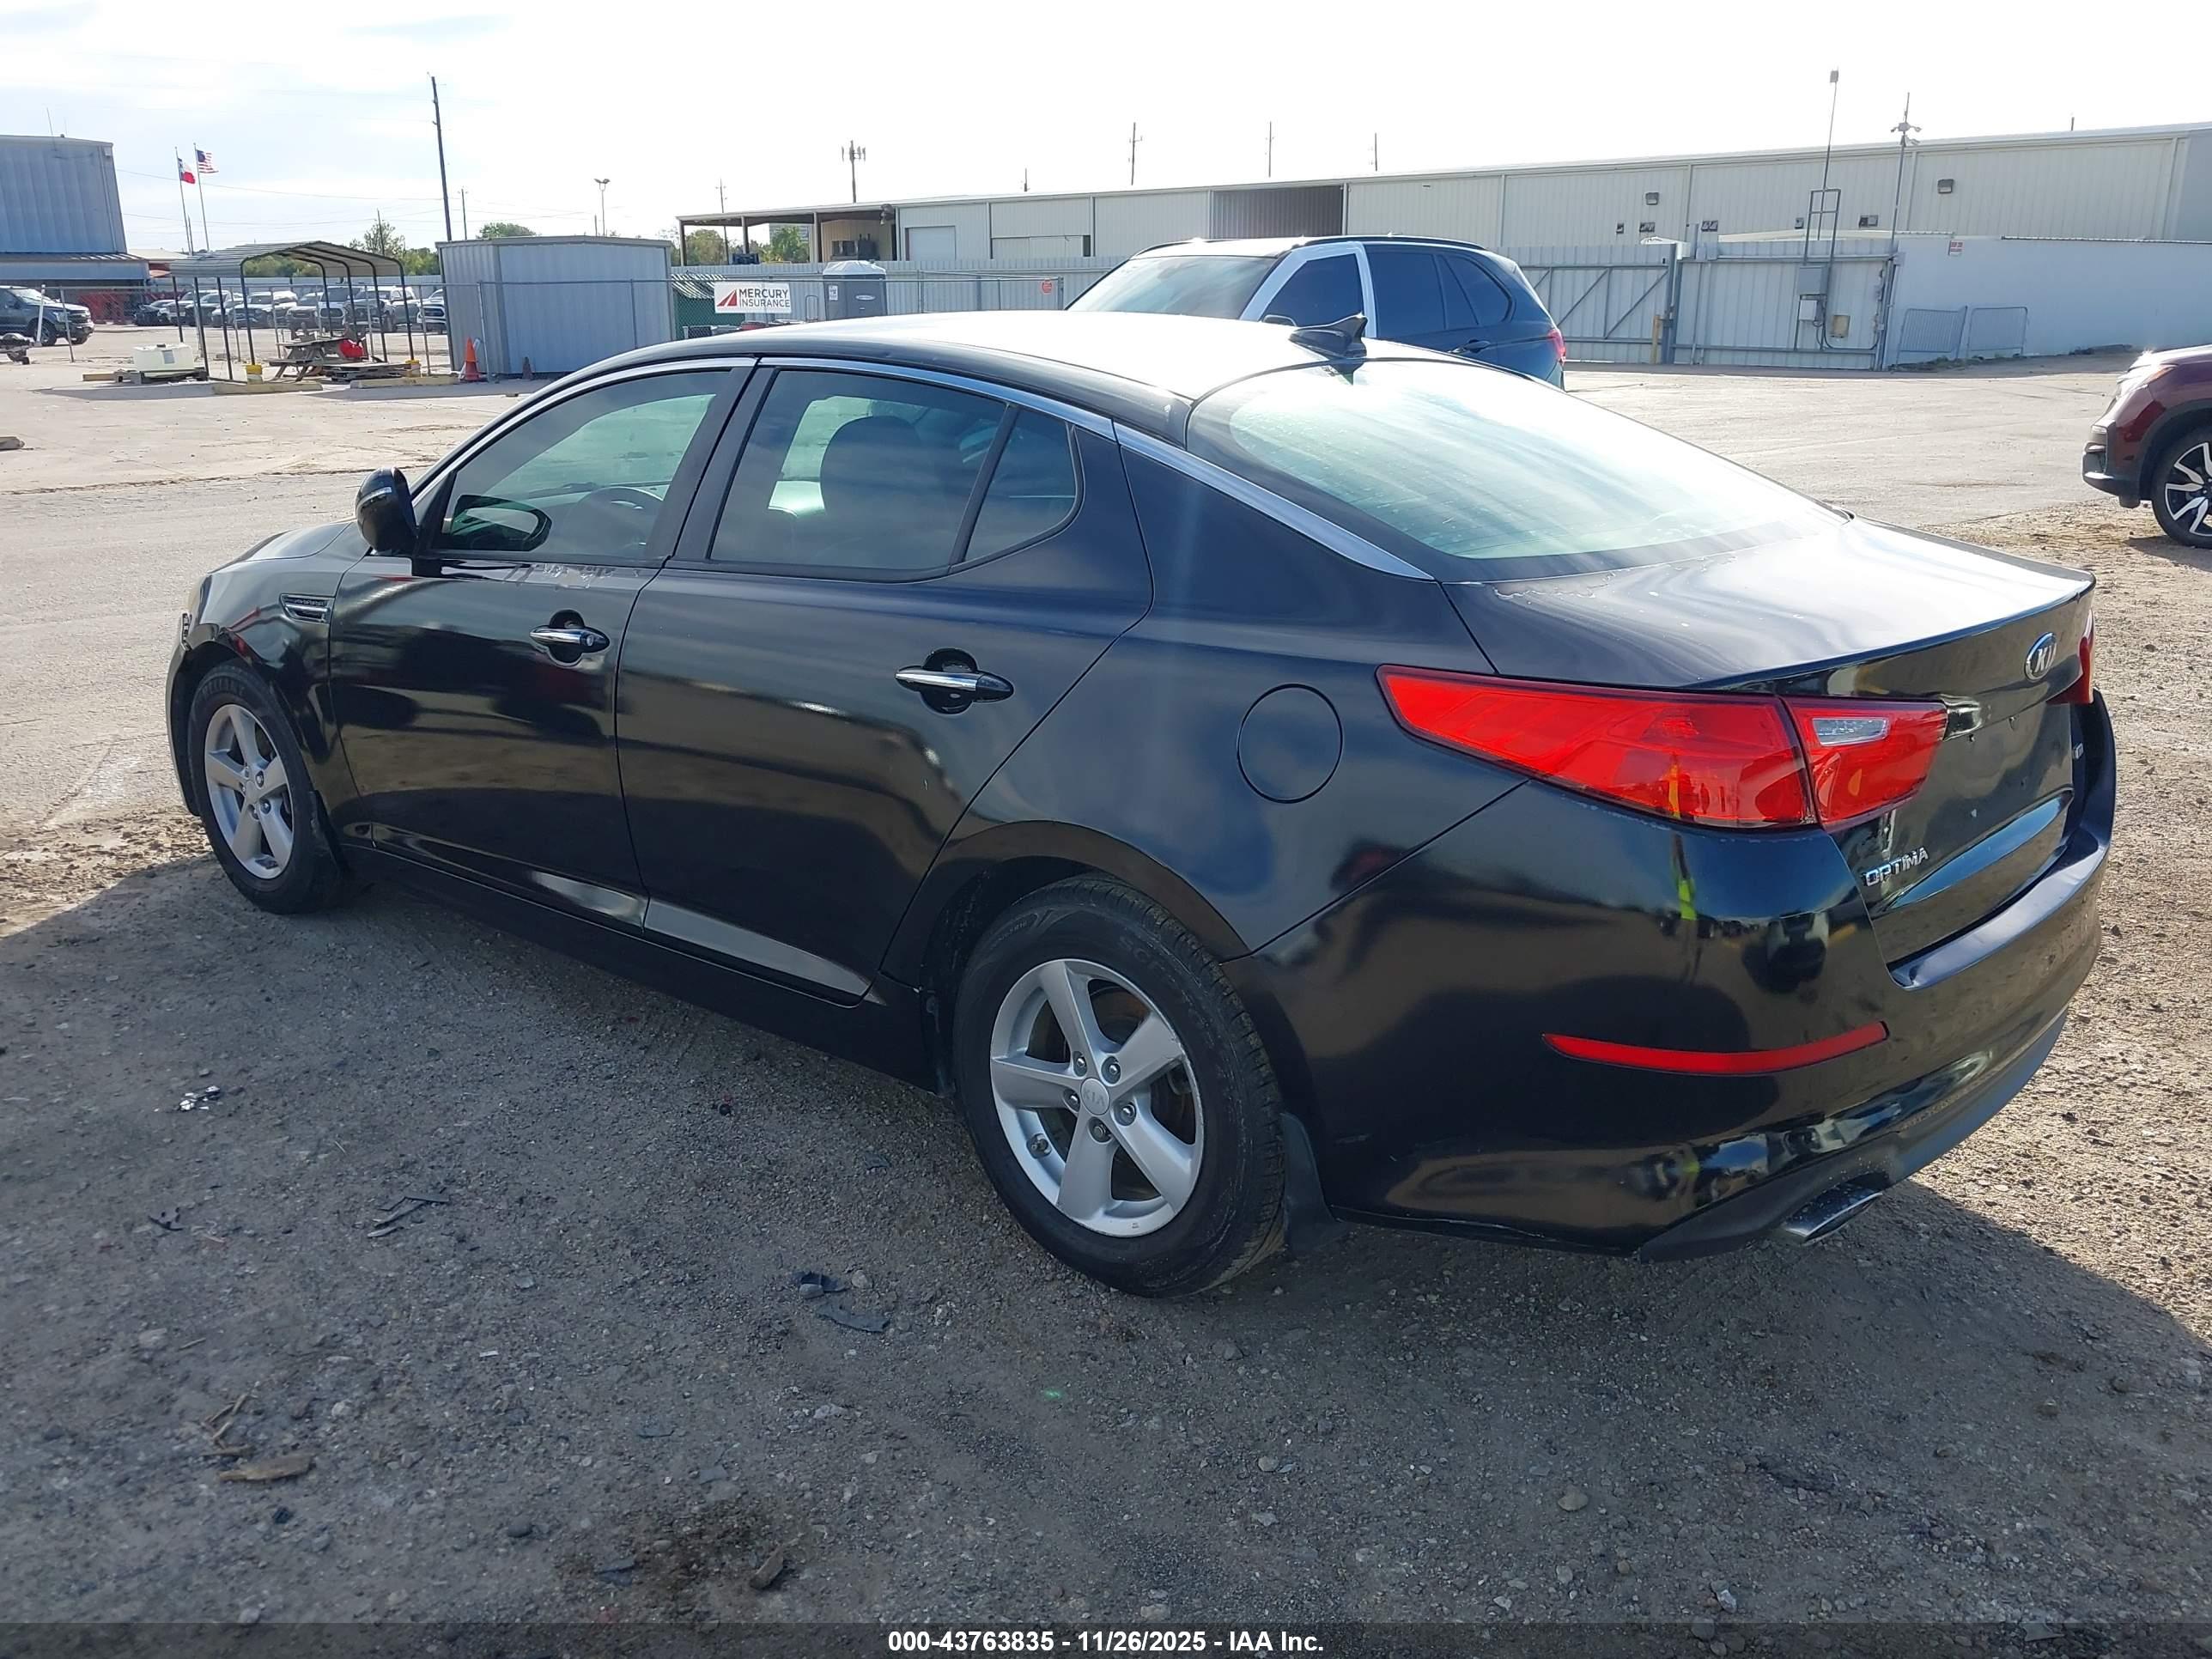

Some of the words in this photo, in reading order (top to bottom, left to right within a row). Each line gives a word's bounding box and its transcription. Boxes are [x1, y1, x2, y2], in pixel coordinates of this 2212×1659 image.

[739, 288, 788, 299] MERCURY
[740, 299, 791, 307] INSURANCE
[1864, 847, 1929, 887] OPTIMA
[1084, 1088, 1107, 1107] KIA
